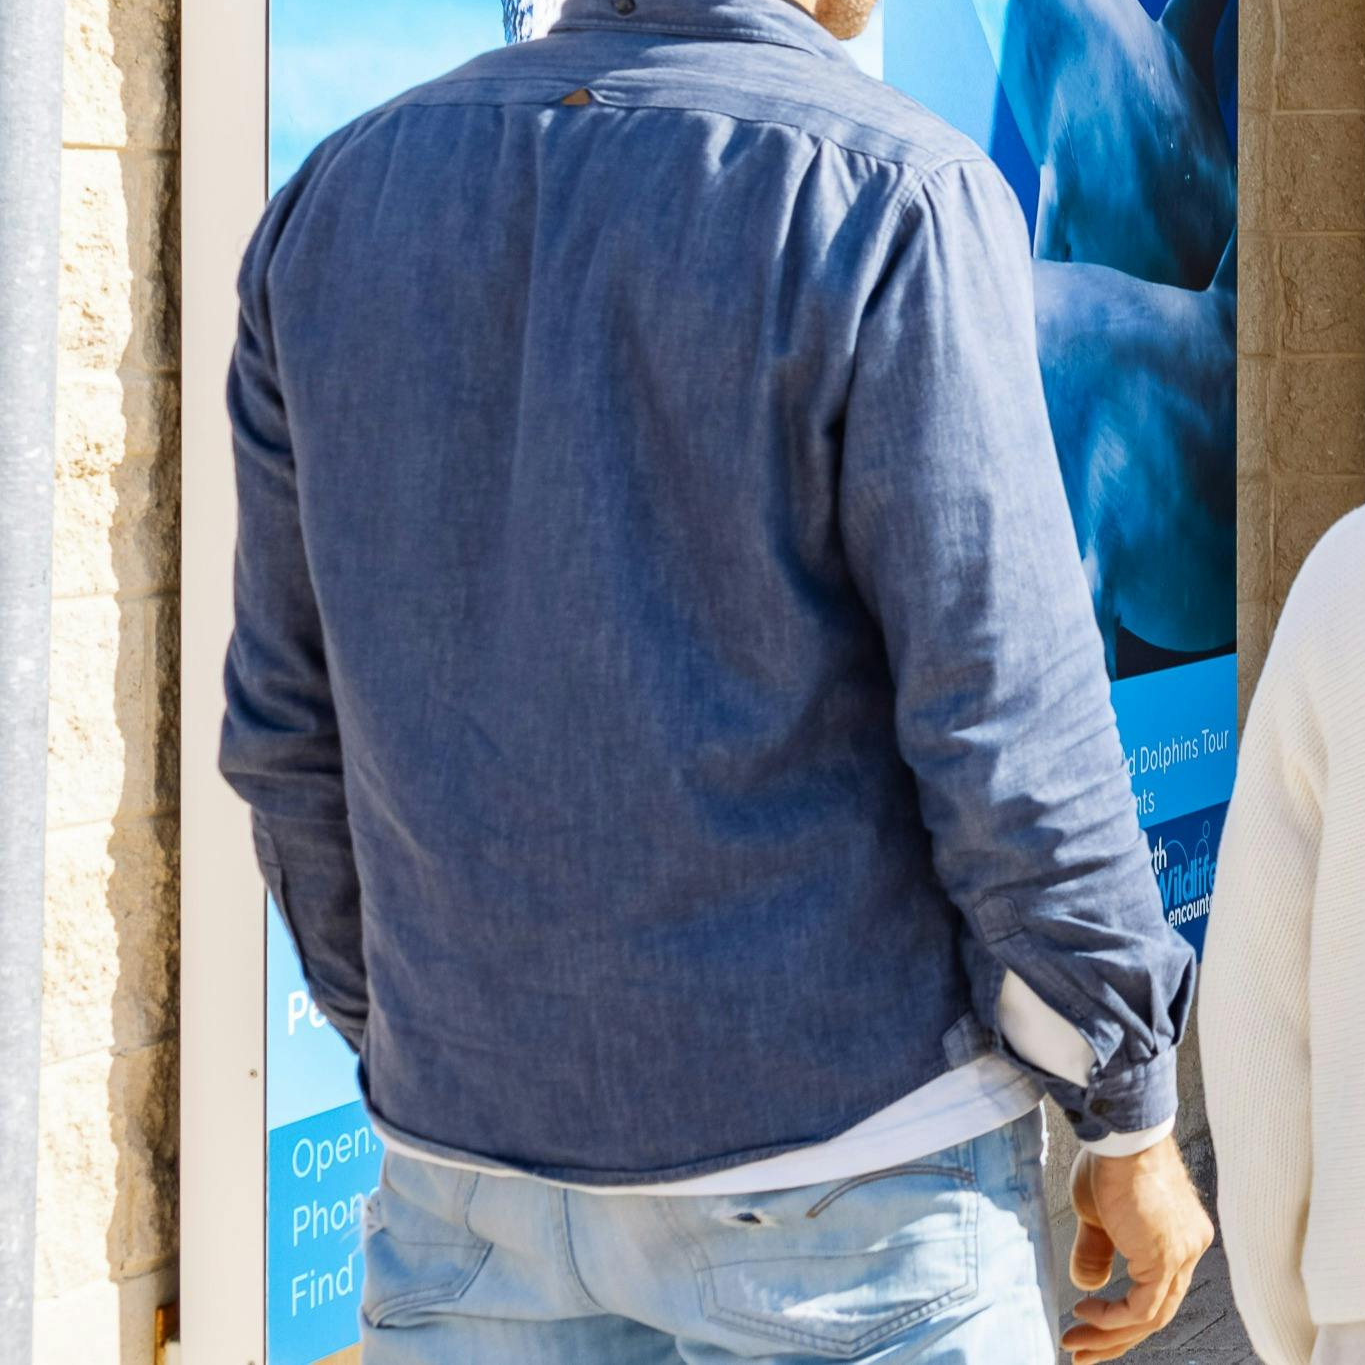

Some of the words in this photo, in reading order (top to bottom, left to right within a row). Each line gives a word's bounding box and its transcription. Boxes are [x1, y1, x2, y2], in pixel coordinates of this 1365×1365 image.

[1140, 735, 1199, 775] Dolphins
[1201, 728, 1229, 755] Tour
[1168, 892, 1211, 928] encount
[293, 1186, 379, 1247] Phon
[291, 1253, 354, 1317] Find
